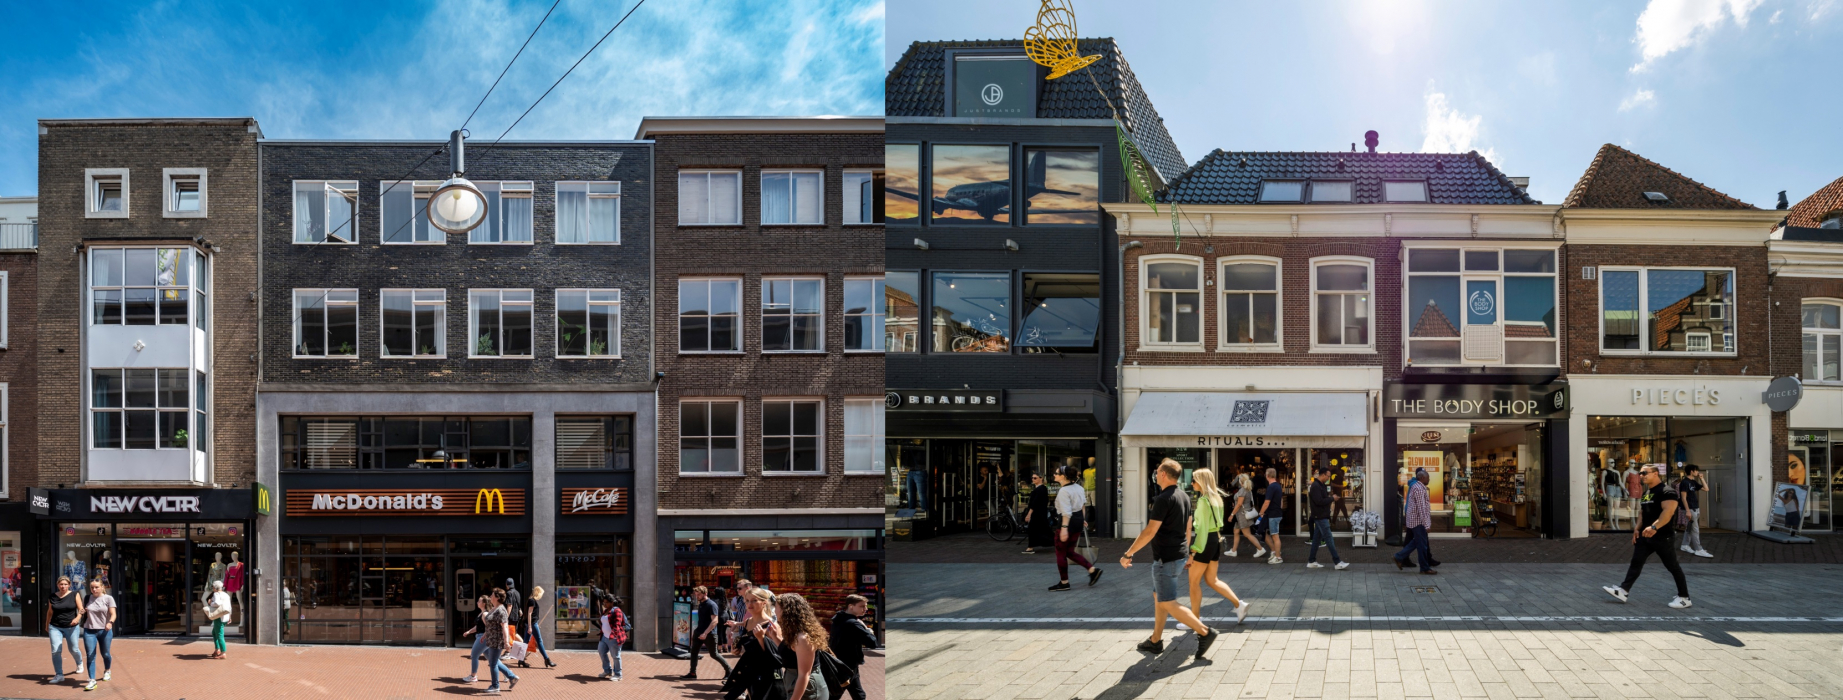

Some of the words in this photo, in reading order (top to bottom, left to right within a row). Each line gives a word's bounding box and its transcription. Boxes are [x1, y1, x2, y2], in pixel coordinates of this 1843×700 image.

[908, 395, 996, 405] BRANDS
[1631, 388, 1721, 405] PIECES
[1768, 389, 1798, 399] PIECES
[1391, 399, 1426, 414] THE
[1434, 399, 1484, 414] BODY
[1424, 456, 1440, 466] HARD
[33, 494, 48, 503] NEW
[90, 495, 139, 513] NEW
[311, 493, 443, 510] McDonald's
